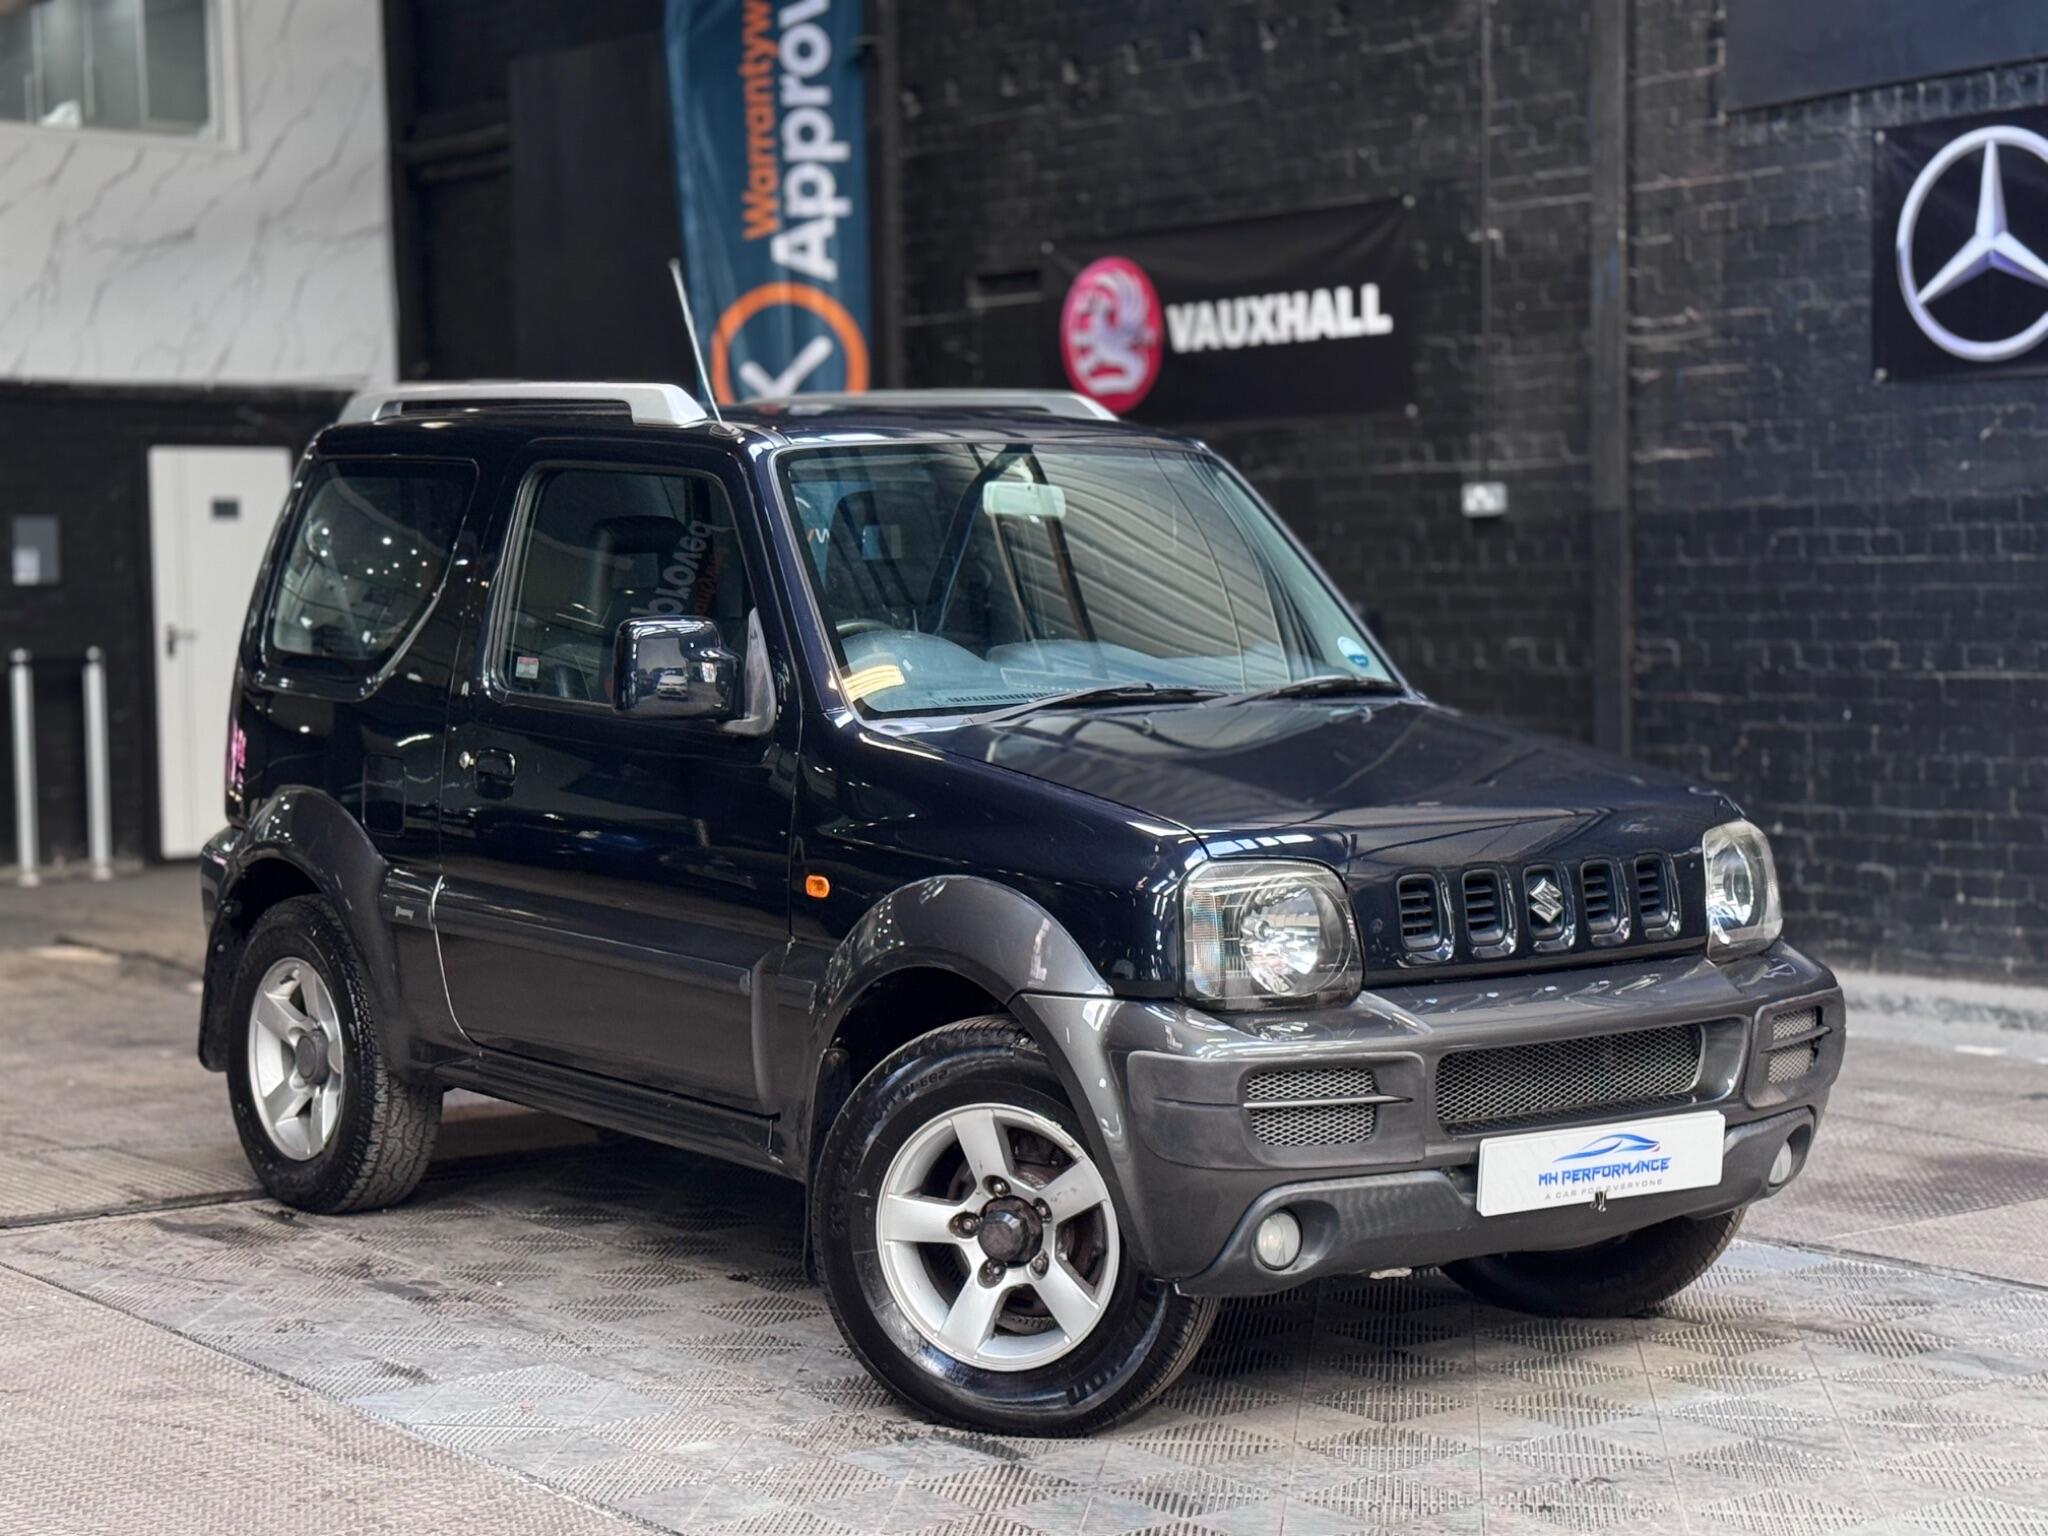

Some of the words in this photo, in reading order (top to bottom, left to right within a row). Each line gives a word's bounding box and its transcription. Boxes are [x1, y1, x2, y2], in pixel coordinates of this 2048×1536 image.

[1165, 282, 1394, 354] VAUXHALL
[1538, 1171, 1559, 1187] MH
[1561, 1157, 1672, 1186] PERFORMANCE
[1555, 1189, 1577, 1199] CAR
